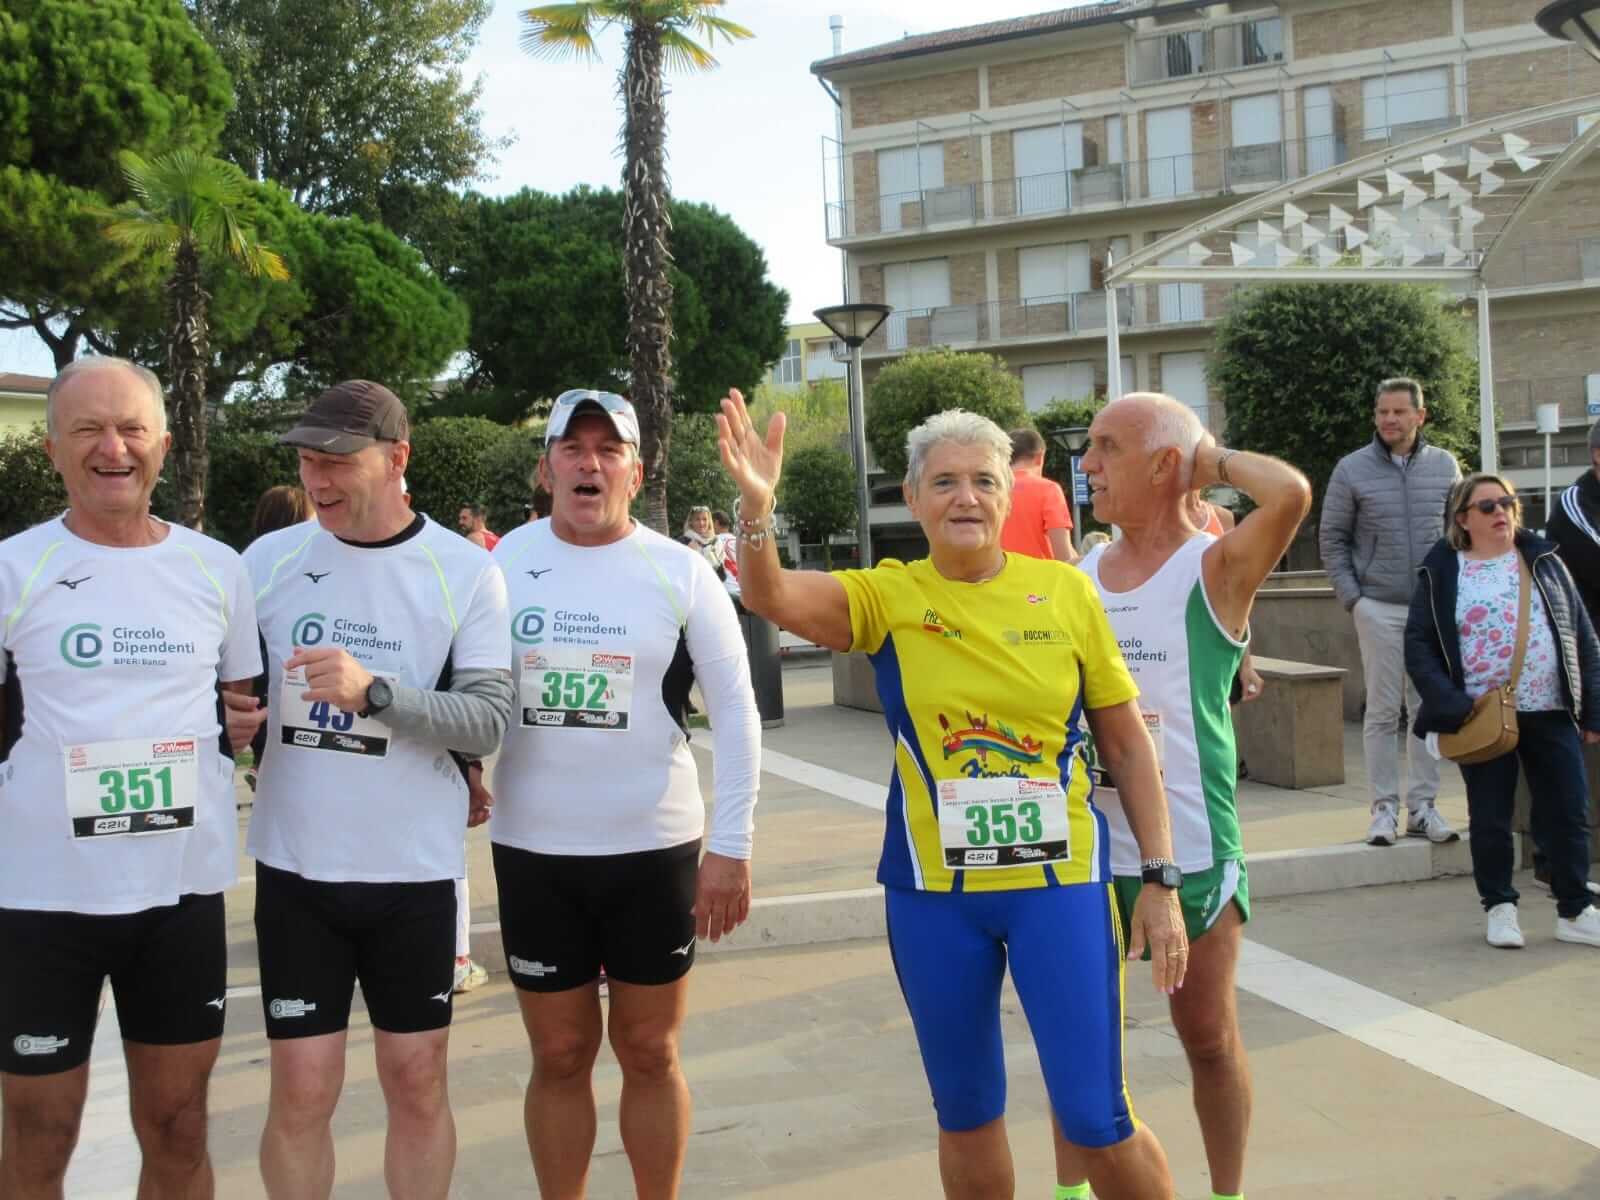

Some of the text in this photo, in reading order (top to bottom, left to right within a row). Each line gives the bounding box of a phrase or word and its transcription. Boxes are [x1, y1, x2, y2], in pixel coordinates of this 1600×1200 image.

[554, 610, 600, 623] Circolo
[334, 618, 378, 634] Circolo
[553, 622, 627, 636] Dipendenti
[112, 627, 166, 640] Circolo
[113, 641, 195, 655] Dipendenti
[332, 632, 402, 651] Dipendenti
[1117, 637, 1142, 648] colo
[1121, 650, 1167, 662] endenti
[542, 671, 608, 709] 352
[99, 766, 172, 813] 351
[97, 820, 128, 830] 42K
[965, 801, 1042, 846] 353
[967, 852, 995, 862] 42K
